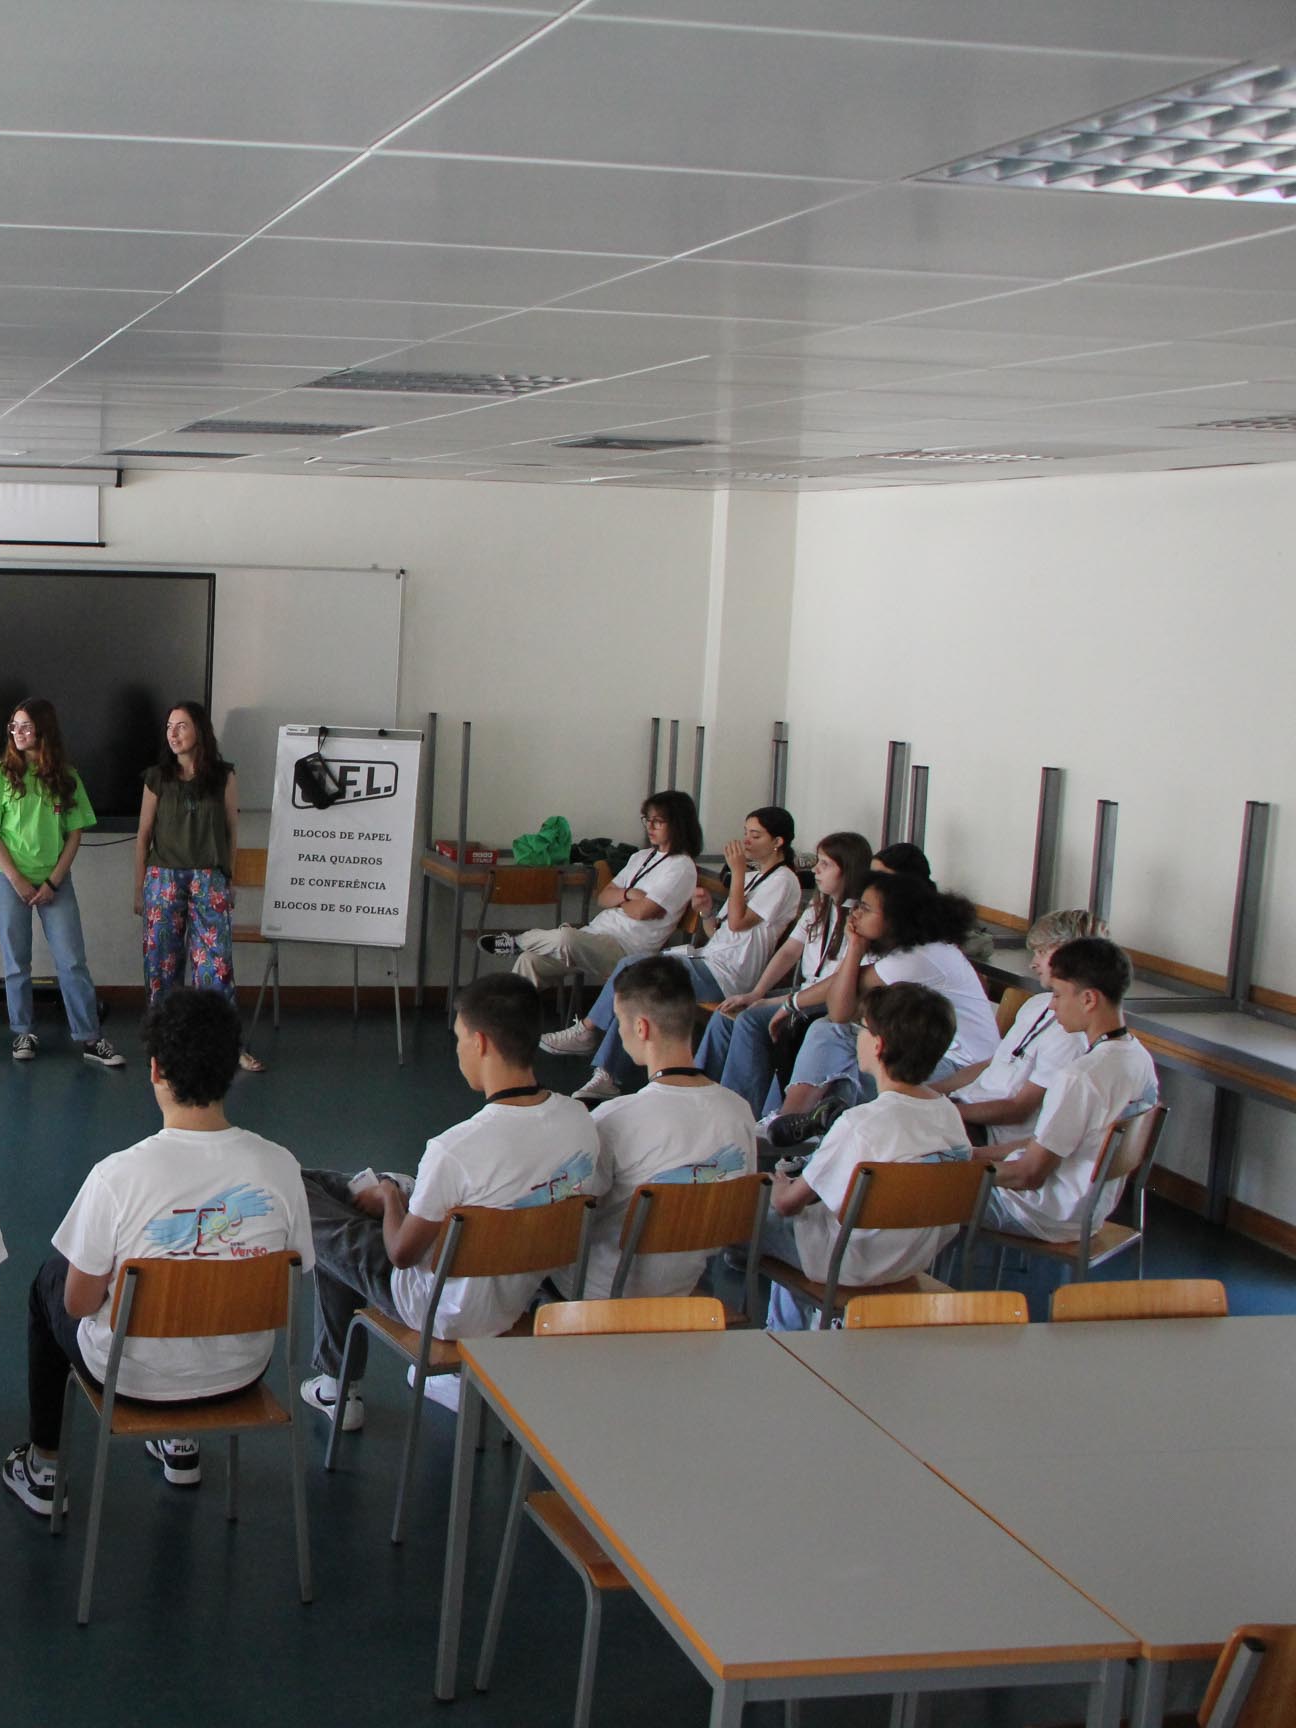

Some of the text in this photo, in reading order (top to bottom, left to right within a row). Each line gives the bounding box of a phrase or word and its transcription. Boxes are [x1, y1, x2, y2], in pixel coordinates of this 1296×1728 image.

[292, 829, 392, 842] BLOCOS DE PAPEL
[298, 853, 383, 866] PARA QUADROS
[290, 877, 387, 891] DE CONFERÊNCIA
[273, 900, 400, 916] BLOCOS DE 50 FOLHAS
[174, 1445, 195, 1453] FILA
